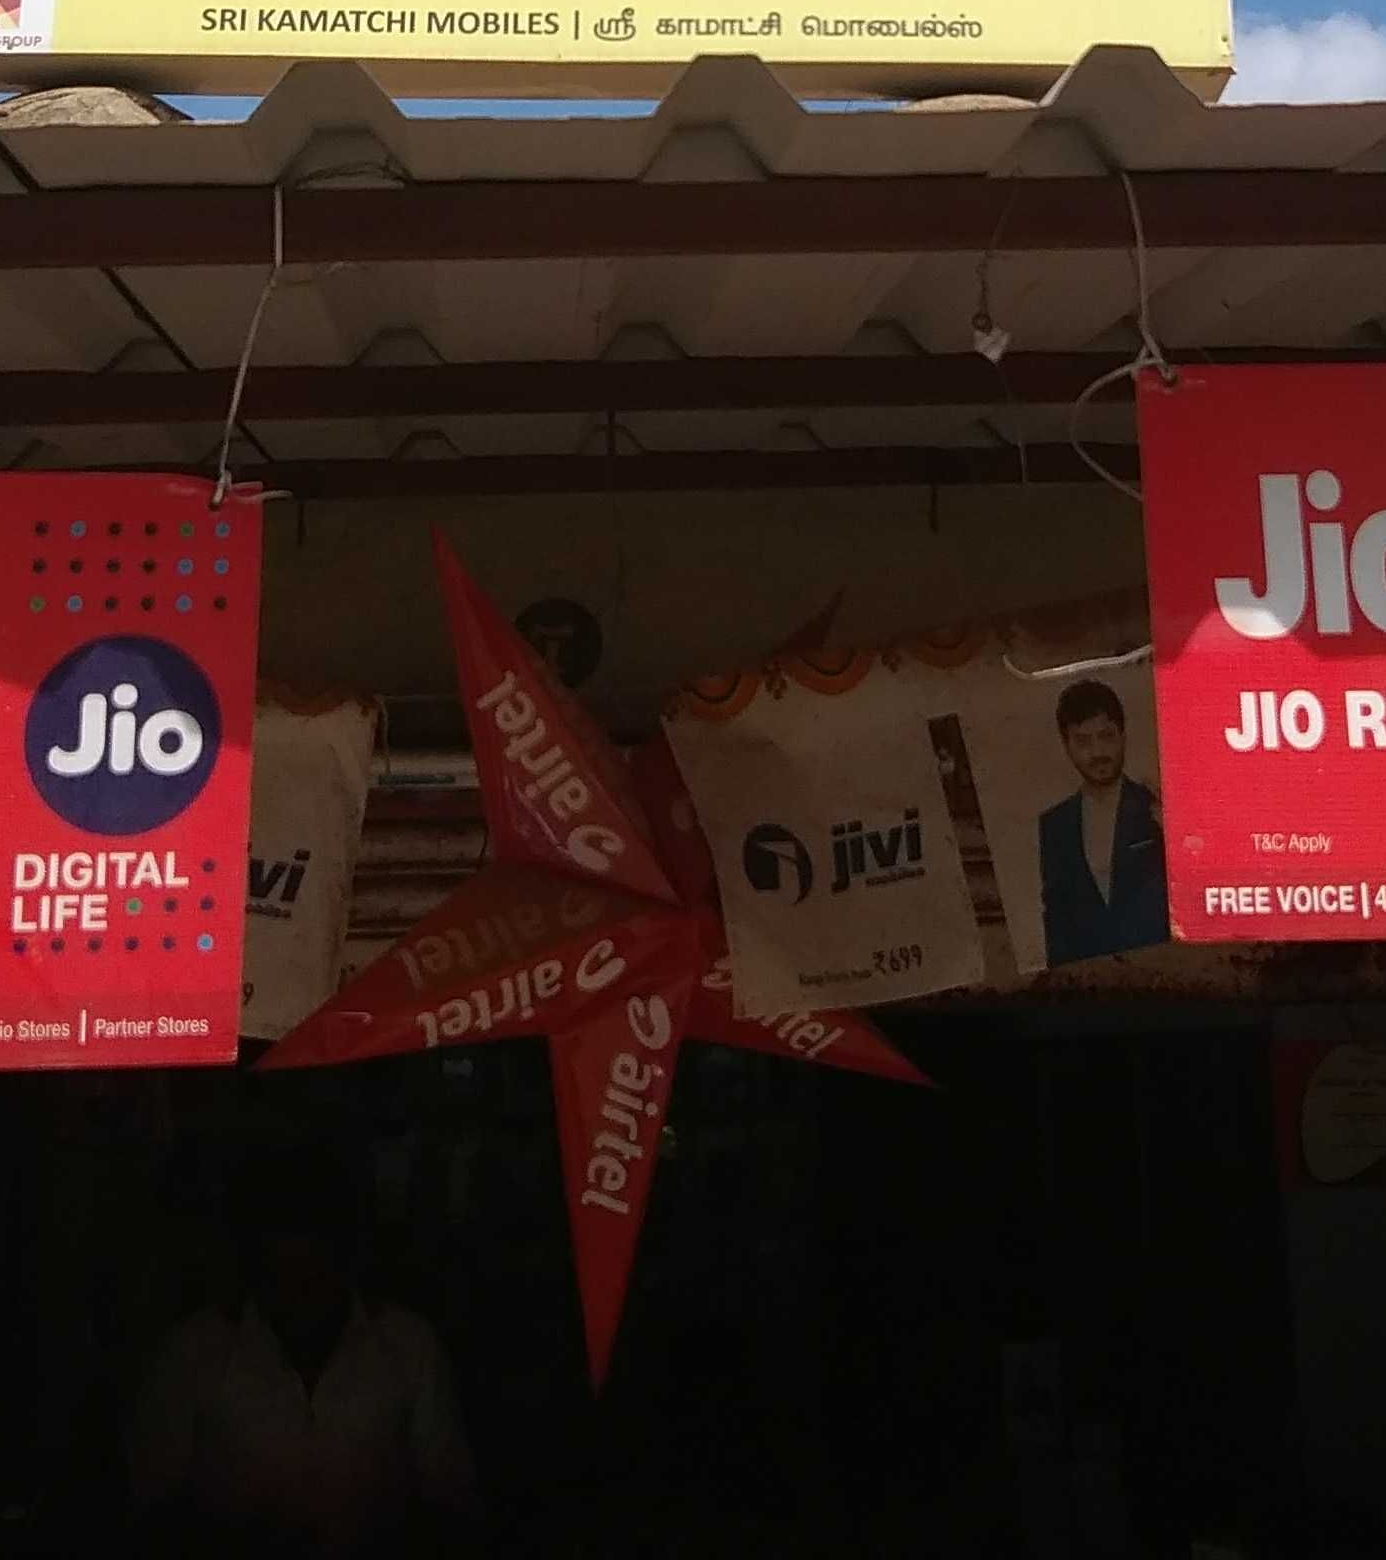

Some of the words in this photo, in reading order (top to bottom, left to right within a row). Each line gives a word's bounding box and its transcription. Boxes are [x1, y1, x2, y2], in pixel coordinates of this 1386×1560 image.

[201, 8, 247, 32] SRI
[257, 8, 416, 34] KAMATCHI
[427, 11, 560, 36] MOBILES
[656, 12, 782, 37] காமாட்சி
[801, 13, 983, 39] மொபைல்ஸ்
[47, 681, 205, 777] Jio
[475, 670, 594, 818] airtel
[1224, 688, 1326, 752] JIO
[831, 808, 923, 894] jivi
[1250, 833, 1286, 851] T&C
[1288, 833, 1334, 854] Apply
[14, 850, 191, 893] DIGITAL
[250, 848, 311, 903] vi
[10, 893, 110, 932] LIFE
[1205, 886, 1272, 915] FREE
[1276, 885, 1356, 914] VOICE
[396, 902, 547, 989] airtel
[94, 1016, 155, 1038] Partner
[157, 1014, 211, 1036] Stores
[415, 958, 566, 1049] airtel
[18, 1019, 72, 1040] Stores
[581, 1050, 659, 1216] airtel
